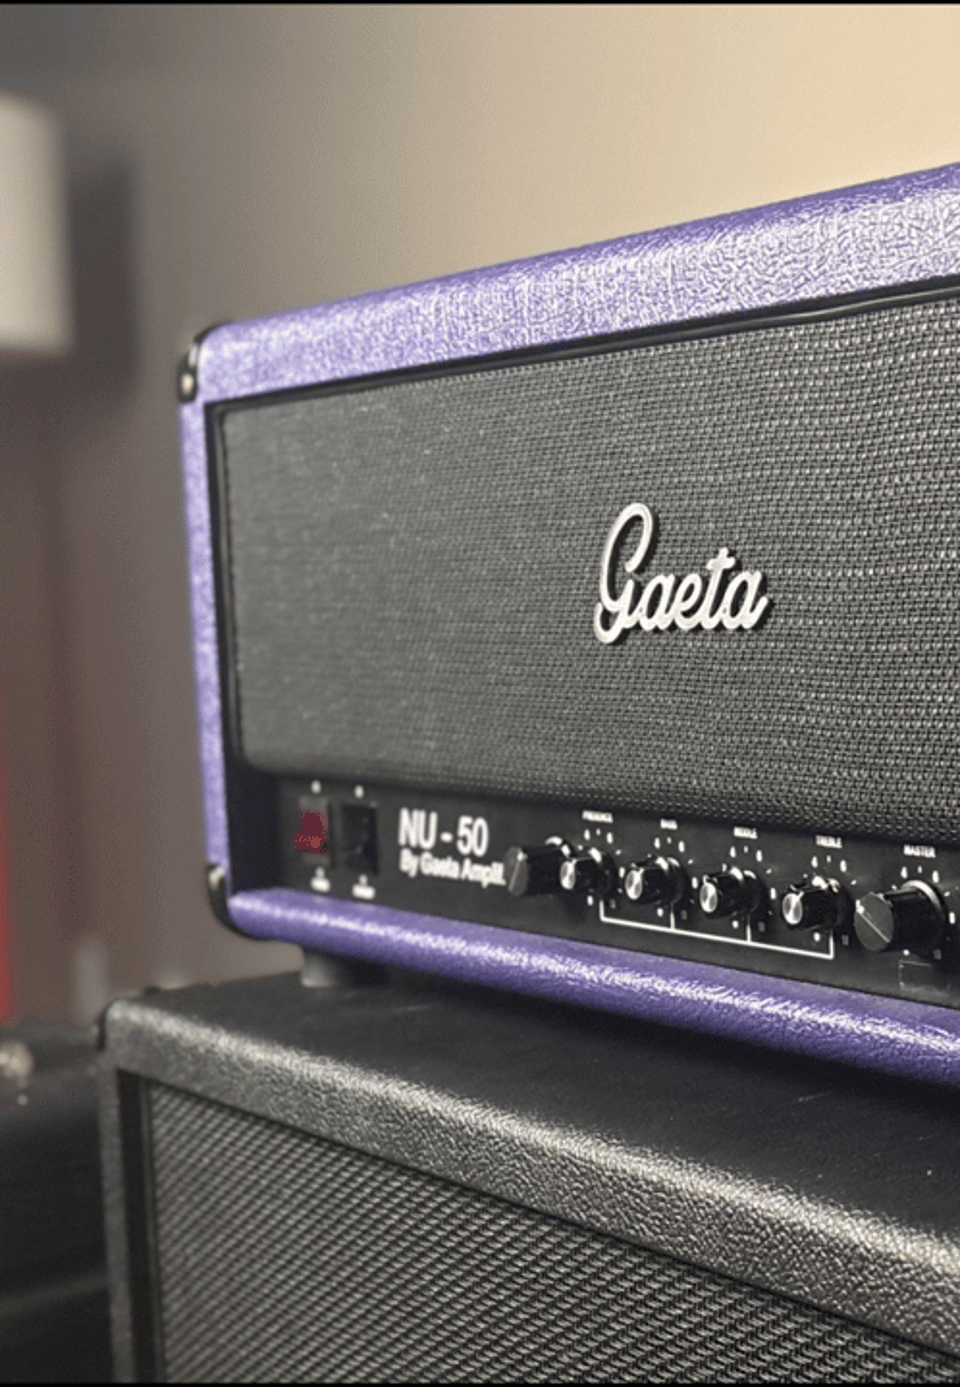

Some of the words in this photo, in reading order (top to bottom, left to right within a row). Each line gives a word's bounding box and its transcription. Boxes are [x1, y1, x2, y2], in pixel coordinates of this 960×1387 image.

[593, 502, 769, 644] Gaeta
[399, 808, 437, 850] NU
[457, 815, 488, 857] 50
[903, 845, 936, 858] MASTER
[400, 848, 419, 877] By
